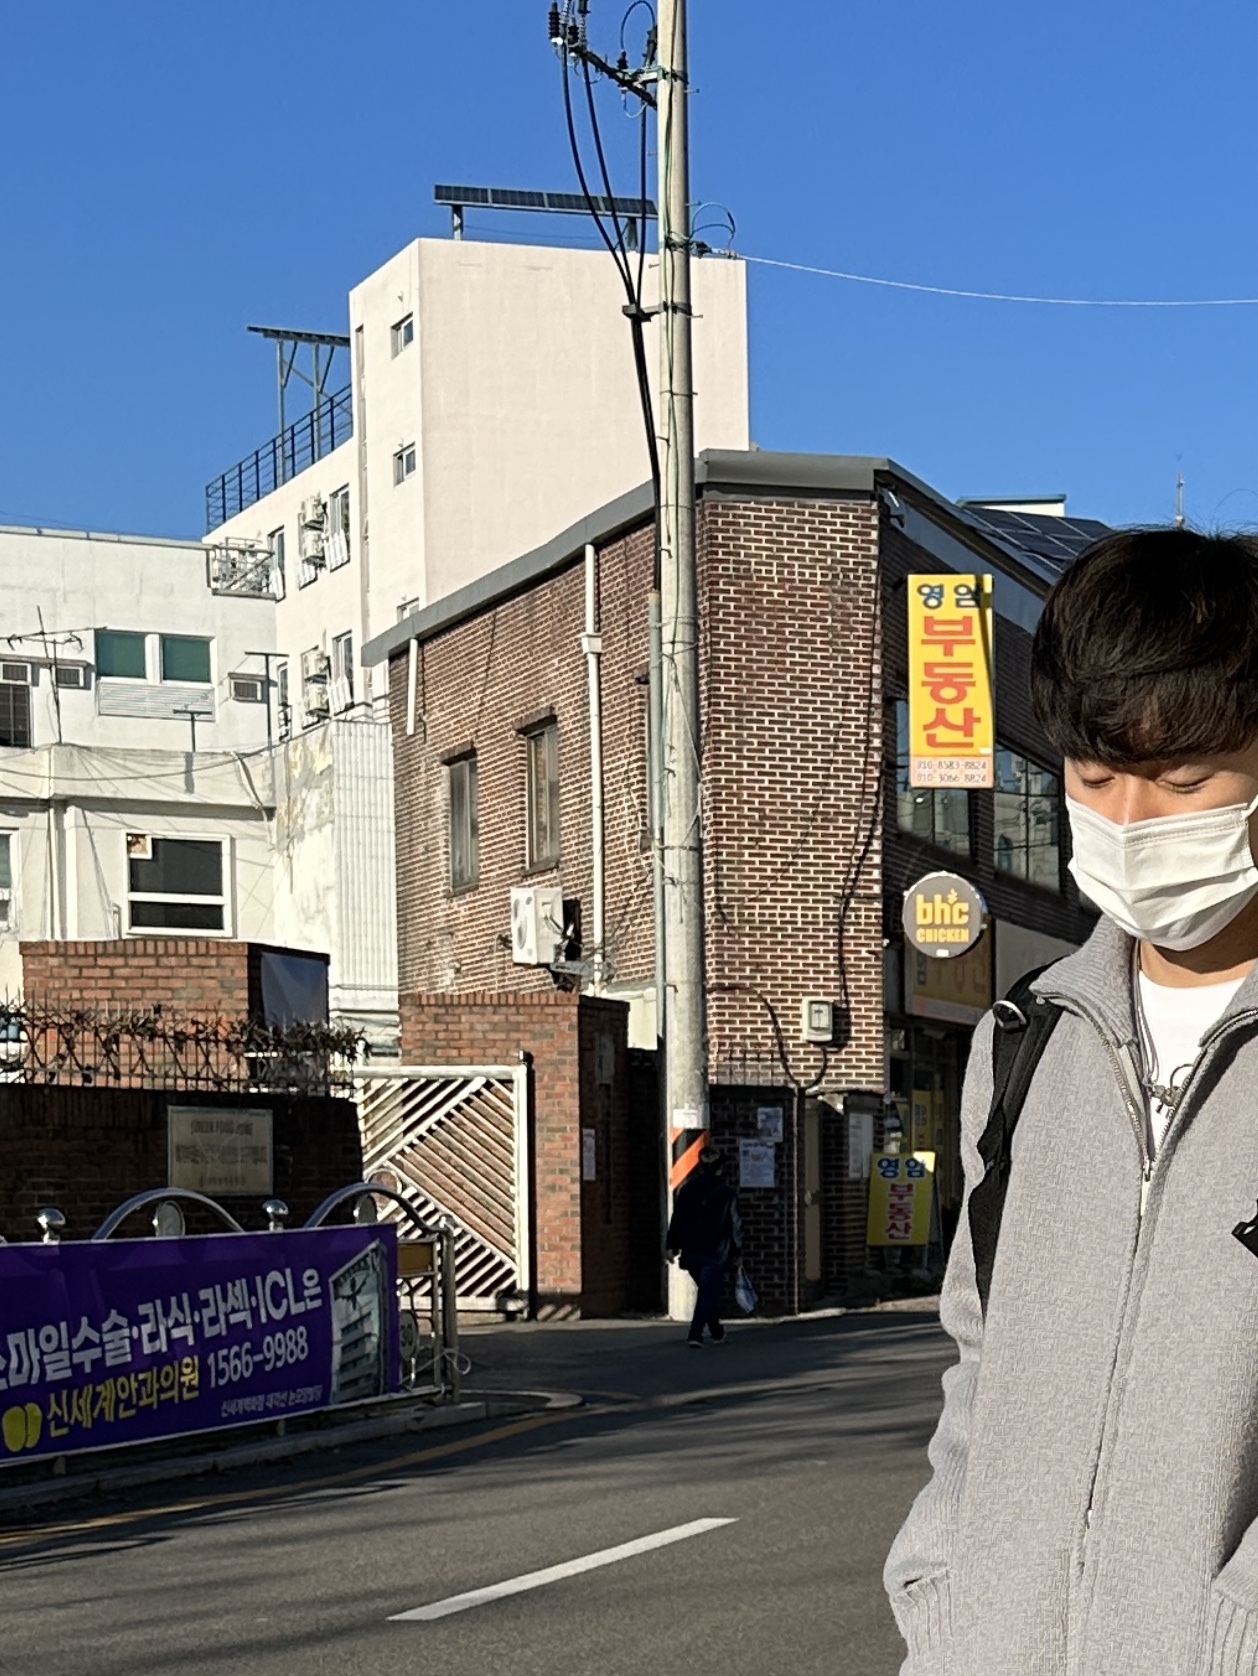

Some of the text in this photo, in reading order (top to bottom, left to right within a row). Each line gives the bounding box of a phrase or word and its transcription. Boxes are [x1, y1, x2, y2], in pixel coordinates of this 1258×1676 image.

[921, 615, 981, 749] 부동산
[916, 894, 969, 925] bhc
[916, 928, 969, 943] CHICKEN
[885, 1183, 914, 1240] 부동산
[0, 1267, 323, 1391] 마일수술·라식·라섹·ICL은
[47, 1326, 308, 1438] 신세계안과의원 1566-9988
